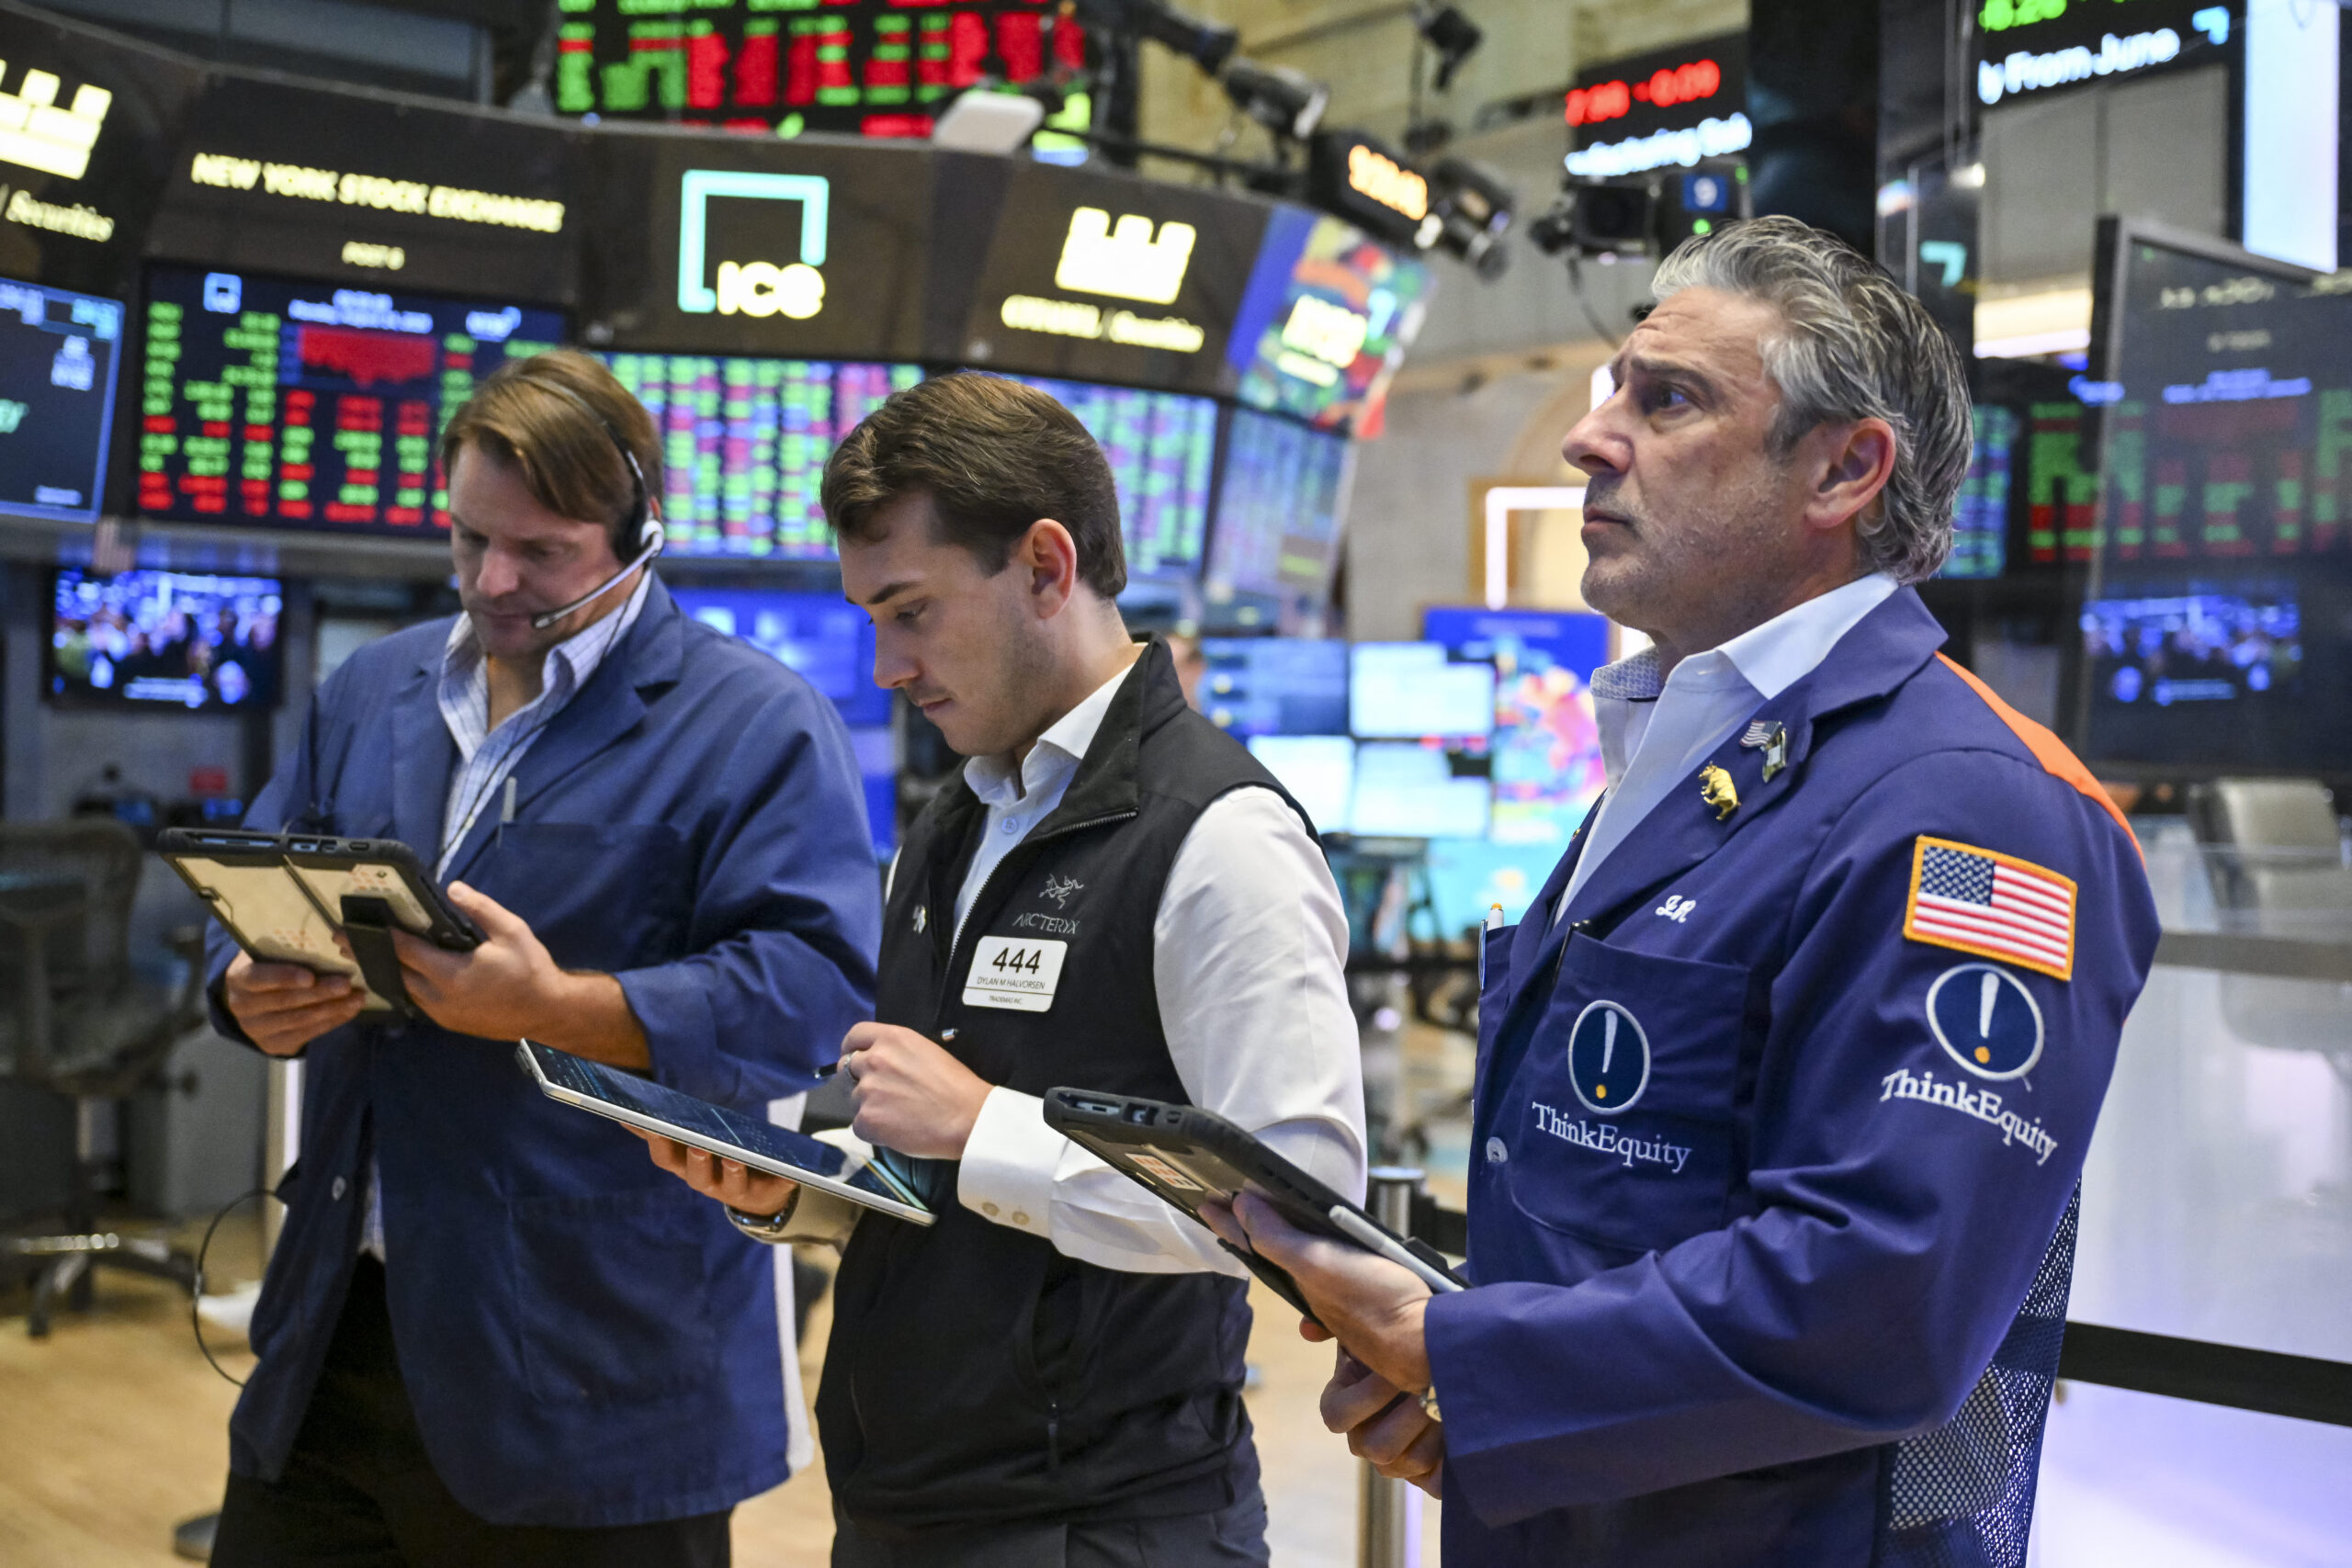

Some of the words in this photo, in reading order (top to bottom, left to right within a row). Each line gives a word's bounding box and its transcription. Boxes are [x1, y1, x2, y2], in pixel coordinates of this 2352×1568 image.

[262, 162, 338, 201] YORK
[338, 173, 429, 214] STOCK
[977, 976, 999, 986] DYLAN
[1007, 979, 1046, 990] HALVORSEN
[992, 947, 1042, 975] 444
[1532, 1101, 1692, 1174] ThinkEquity
[1880, 1068, 2058, 1167] ThinkEquity
